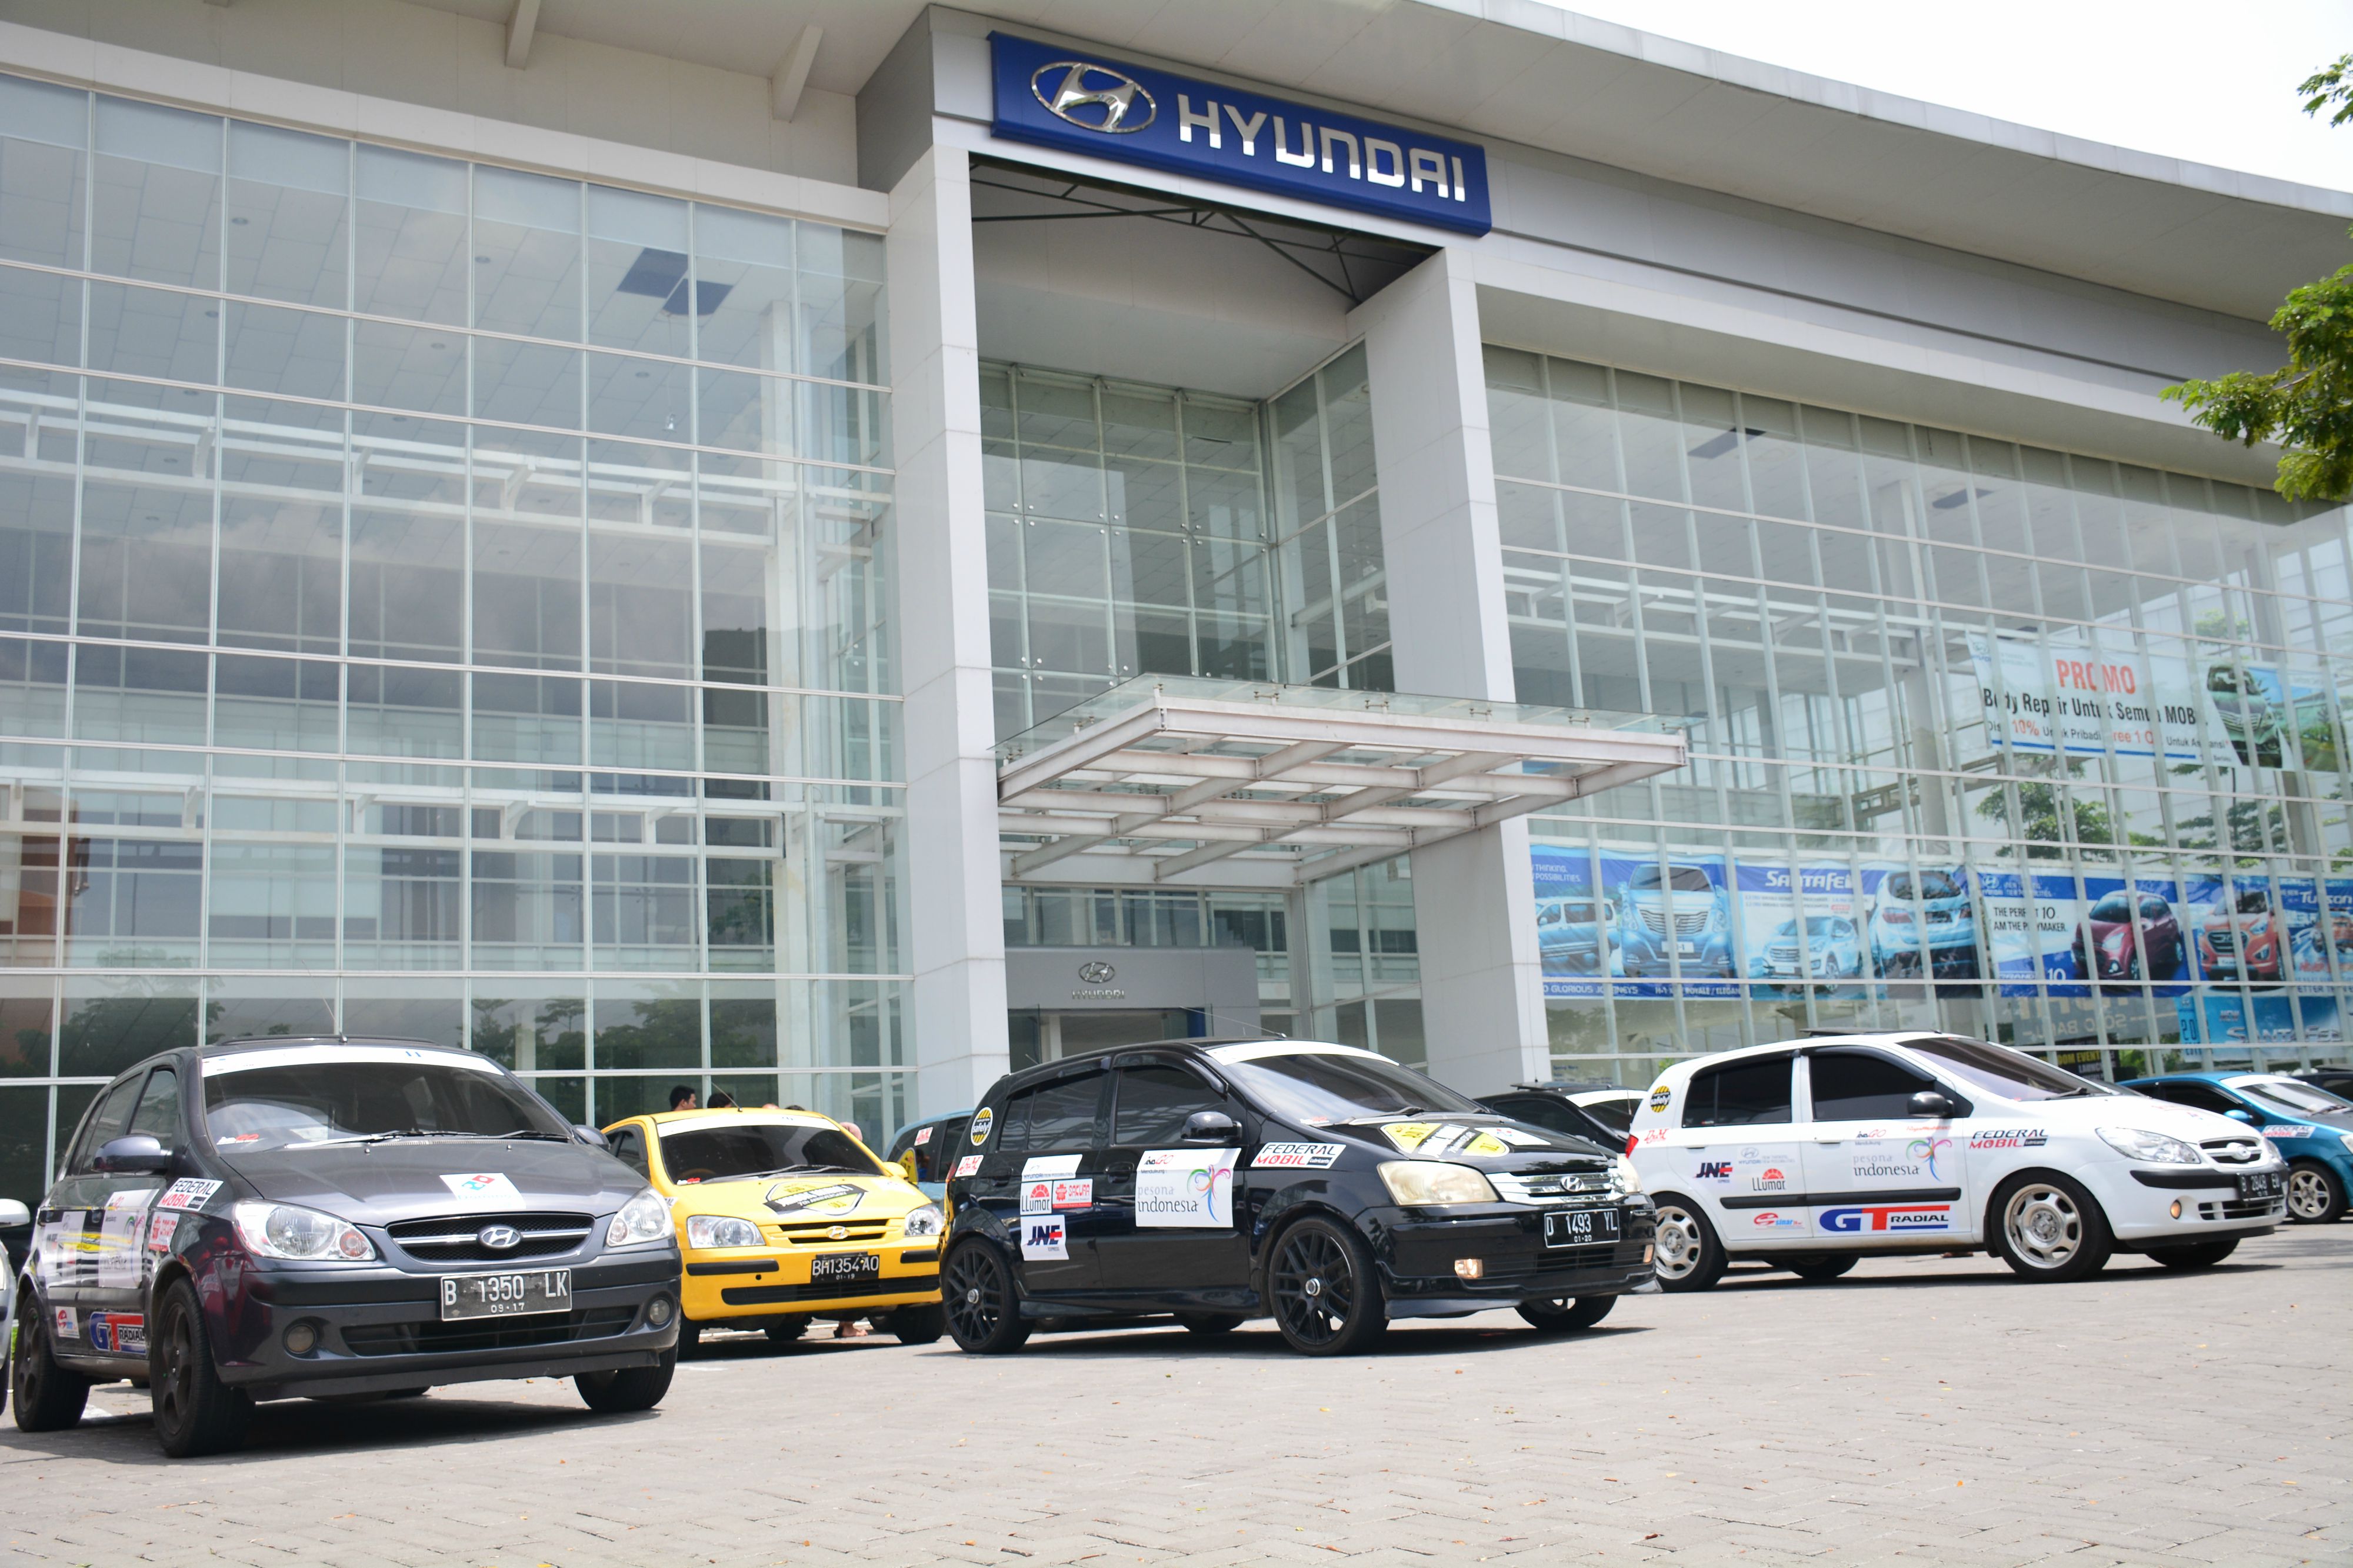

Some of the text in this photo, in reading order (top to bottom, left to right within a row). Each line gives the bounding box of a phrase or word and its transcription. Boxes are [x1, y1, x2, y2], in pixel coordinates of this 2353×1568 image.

[1177, 94, 1467, 202] HYUNDAI
[2056, 659, 2136, 695] PROMO
[2022, 693, 2068, 718] Repir
[2012, 719, 2040, 736] 10%
[2071, 729, 2102, 741] Pribadi
[2112, 730, 2132, 743] ree
[2167, 736, 2189, 747] Untuk
[1994, 906, 2055, 919] THE PERFT 10
[1994, 922, 2068, 932] AM THE PYMAKER.
[1072, 989, 1125, 1000] HYUNDAI
[1550, 985, 1593, 994] GLORIOUS
[1595, 985, 1639, 995] JONEYS
[1972, 1129, 2048, 1139] FEDERAL
[1262, 1144, 1336, 1156] FEDERAL
[1969, 1138, 2024, 1149] MOBIL
[1254, 1155, 1305, 1165] MOBIL
[1854, 1154, 1892, 1165] pesona
[1694, 1162, 1733, 1179] JNE
[1854, 1163, 1920, 1177] indonesia
[170, 1180, 215, 1195] FEDERAL
[1138, 1185, 1175, 1199] pesona
[1752, 1177, 1786, 1192] LLumar
[161, 1193, 191, 1207] MOBIL
[1021, 1195, 1050, 1212] LLumar
[1137, 1196, 1199, 1213] indonesia
[1546, 1212, 1618, 1236] D 1493 YL
[1819, 1205, 1950, 1232] GT RADIAL
[1026, 1225, 1062, 1246] JNE
[444, 1272, 568, 1306] B 1350 LK
[90, 1312, 145, 1352] GT RADIAL
